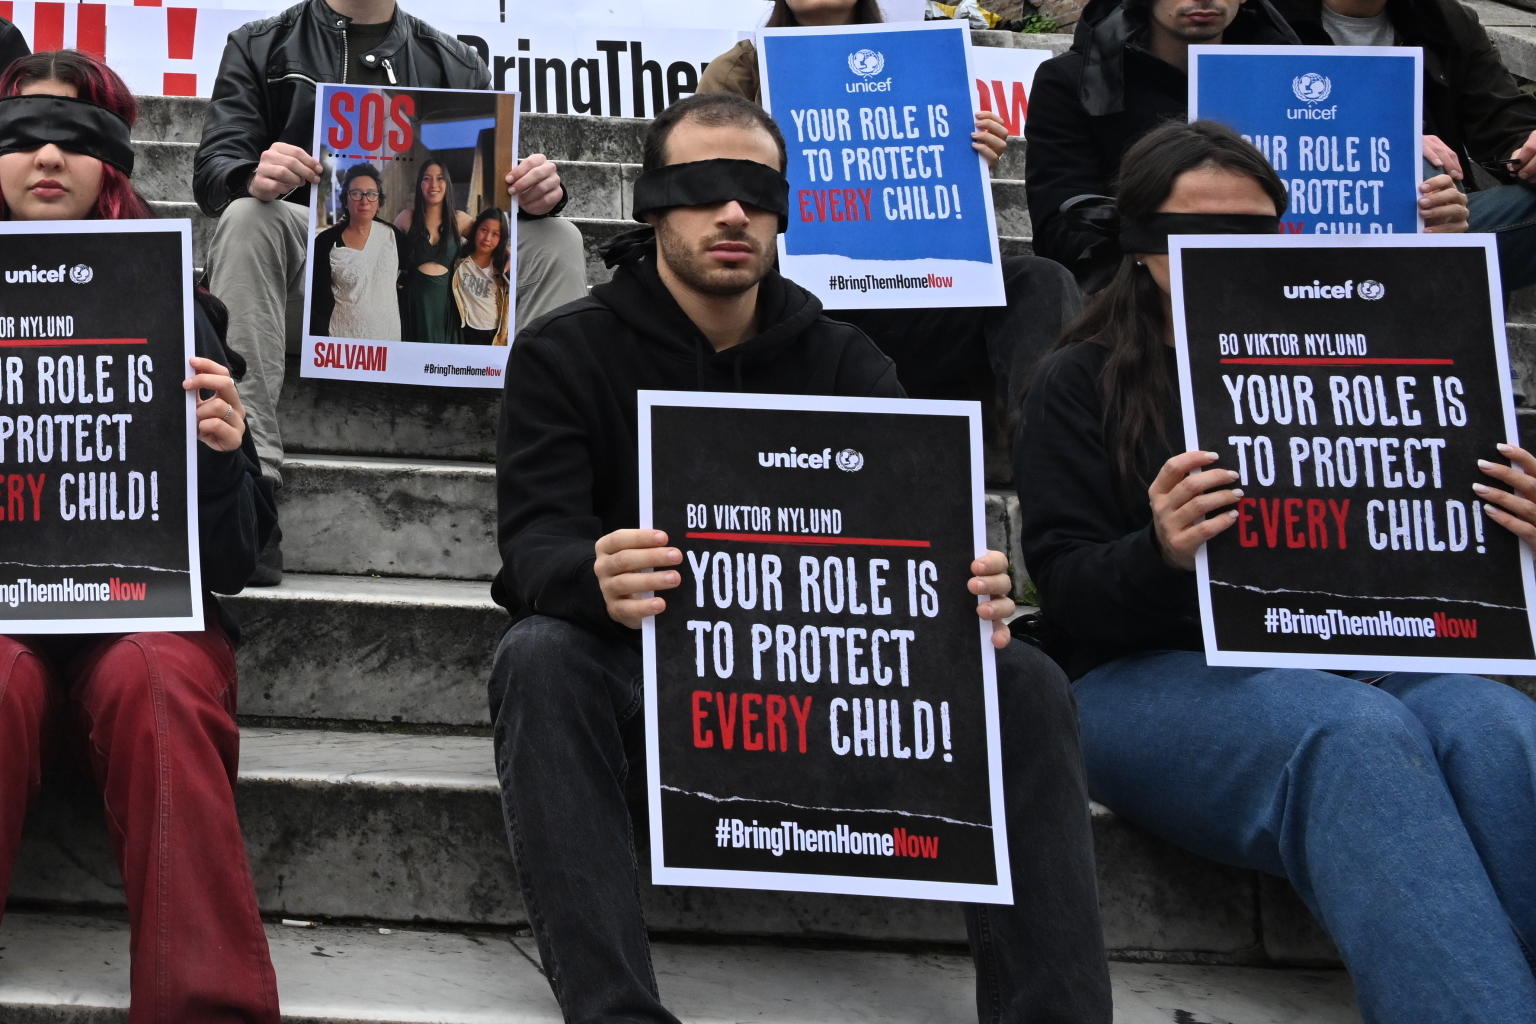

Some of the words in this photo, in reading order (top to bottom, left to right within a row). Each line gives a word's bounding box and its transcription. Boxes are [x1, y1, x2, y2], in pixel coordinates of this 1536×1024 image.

[846, 77, 892, 93] unicef
[328, 92, 415, 153] SOS
[790, 108, 851, 142] YOUR
[859, 106, 917, 140] ROLE
[927, 104, 949, 137] IS
[1287, 105, 1337, 120] unicef
[802, 148, 833, 181] TO
[842, 145, 944, 181] PROTECT
[1299, 136, 1360, 172] ROLE
[1371, 137, 1390, 172] IS
[798, 188, 873, 222] EVERY
[883, 184, 962, 220] CHILD!
[5, 265, 66, 284] unicef
[829, 273, 953, 293] #BringThemHomeNow
[1283, 280, 1353, 300] unicef
[20, 315, 74, 338] NYLUND
[1219, 334, 1238, 355] BO
[1244, 333, 1299, 356] VIKTOR
[1304, 334, 1367, 356] NYLUND
[314, 342, 387, 372] SALVAMI
[424, 364, 501, 377] #BringThemHomeNow
[38, 354, 113, 404] ROLE
[127, 354, 153, 403] IS
[1221, 374, 1318, 426] YOUR
[1329, 375, 1422, 426] ROLE
[1433, 376, 1467, 427] IS
[758, 446, 831, 470] unicef
[1228, 435, 1276, 487] TO
[1289, 437, 1446, 489] PROTECT
[59, 471, 159, 521] CHILD!
[687, 504, 707, 529] BO
[713, 504, 771, 532] VIKTOR
[777, 508, 842, 535] NYLUND
[1238, 498, 1350, 550] EVERY
[1366, 499, 1486, 554] CHILD!
[687, 550, 783, 612] YOUR
[799, 555, 891, 616] ROLE
[907, 559, 939, 618] IS
[1264, 608, 1477, 639] #BringThemHomeNow
[686, 620, 734, 679] TO
[751, 623, 915, 687] PROTECT
[690, 690, 813, 754] EVERY
[829, 697, 953, 763] CHILD!
[716, 818, 939, 859] #BringThemHomeNow
